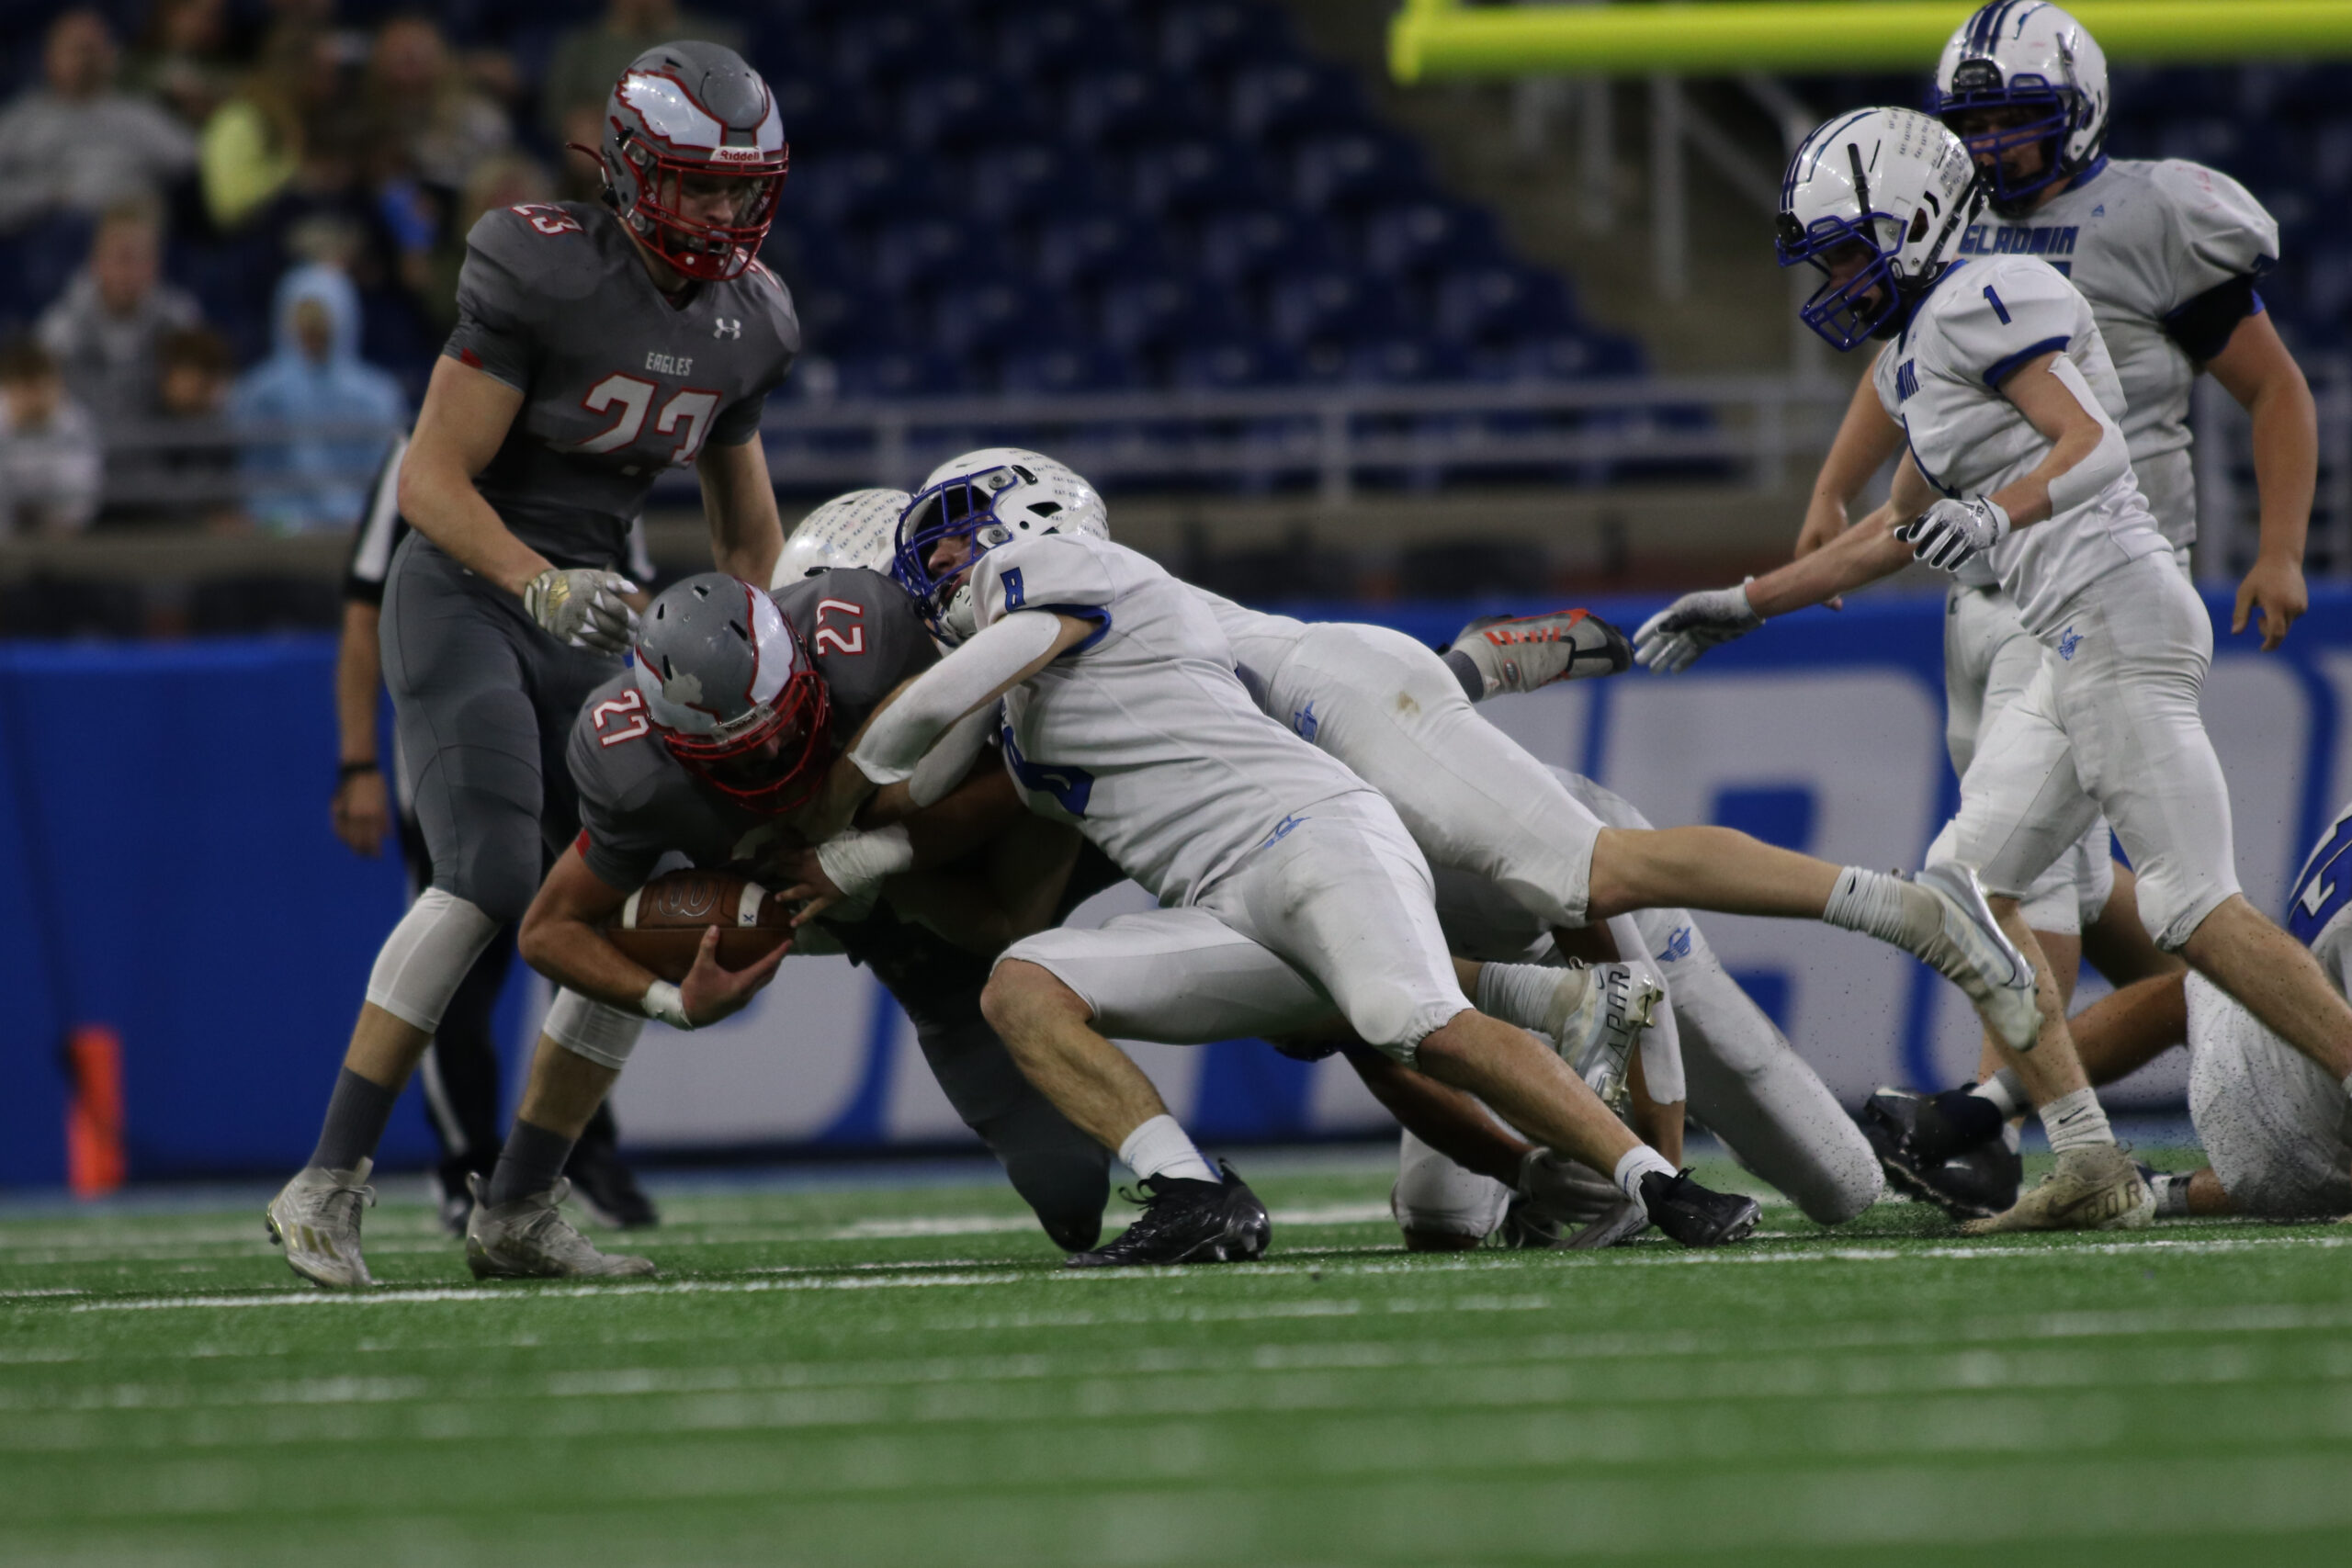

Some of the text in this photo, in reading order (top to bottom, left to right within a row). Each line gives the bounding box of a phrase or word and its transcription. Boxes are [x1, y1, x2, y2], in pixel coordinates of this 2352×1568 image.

[719, 150, 762, 162] Riddell
[1958, 225, 2079, 255] GLADWIN
[1983, 285, 2012, 325] 1
[645, 352, 694, 377] EAGLES
[580, 369, 723, 470] 23
[1000, 566, 1027, 612] 8
[814, 597, 866, 657] 27
[592, 687, 653, 749] 27
[1606, 969, 1632, 1079] VAPOR
